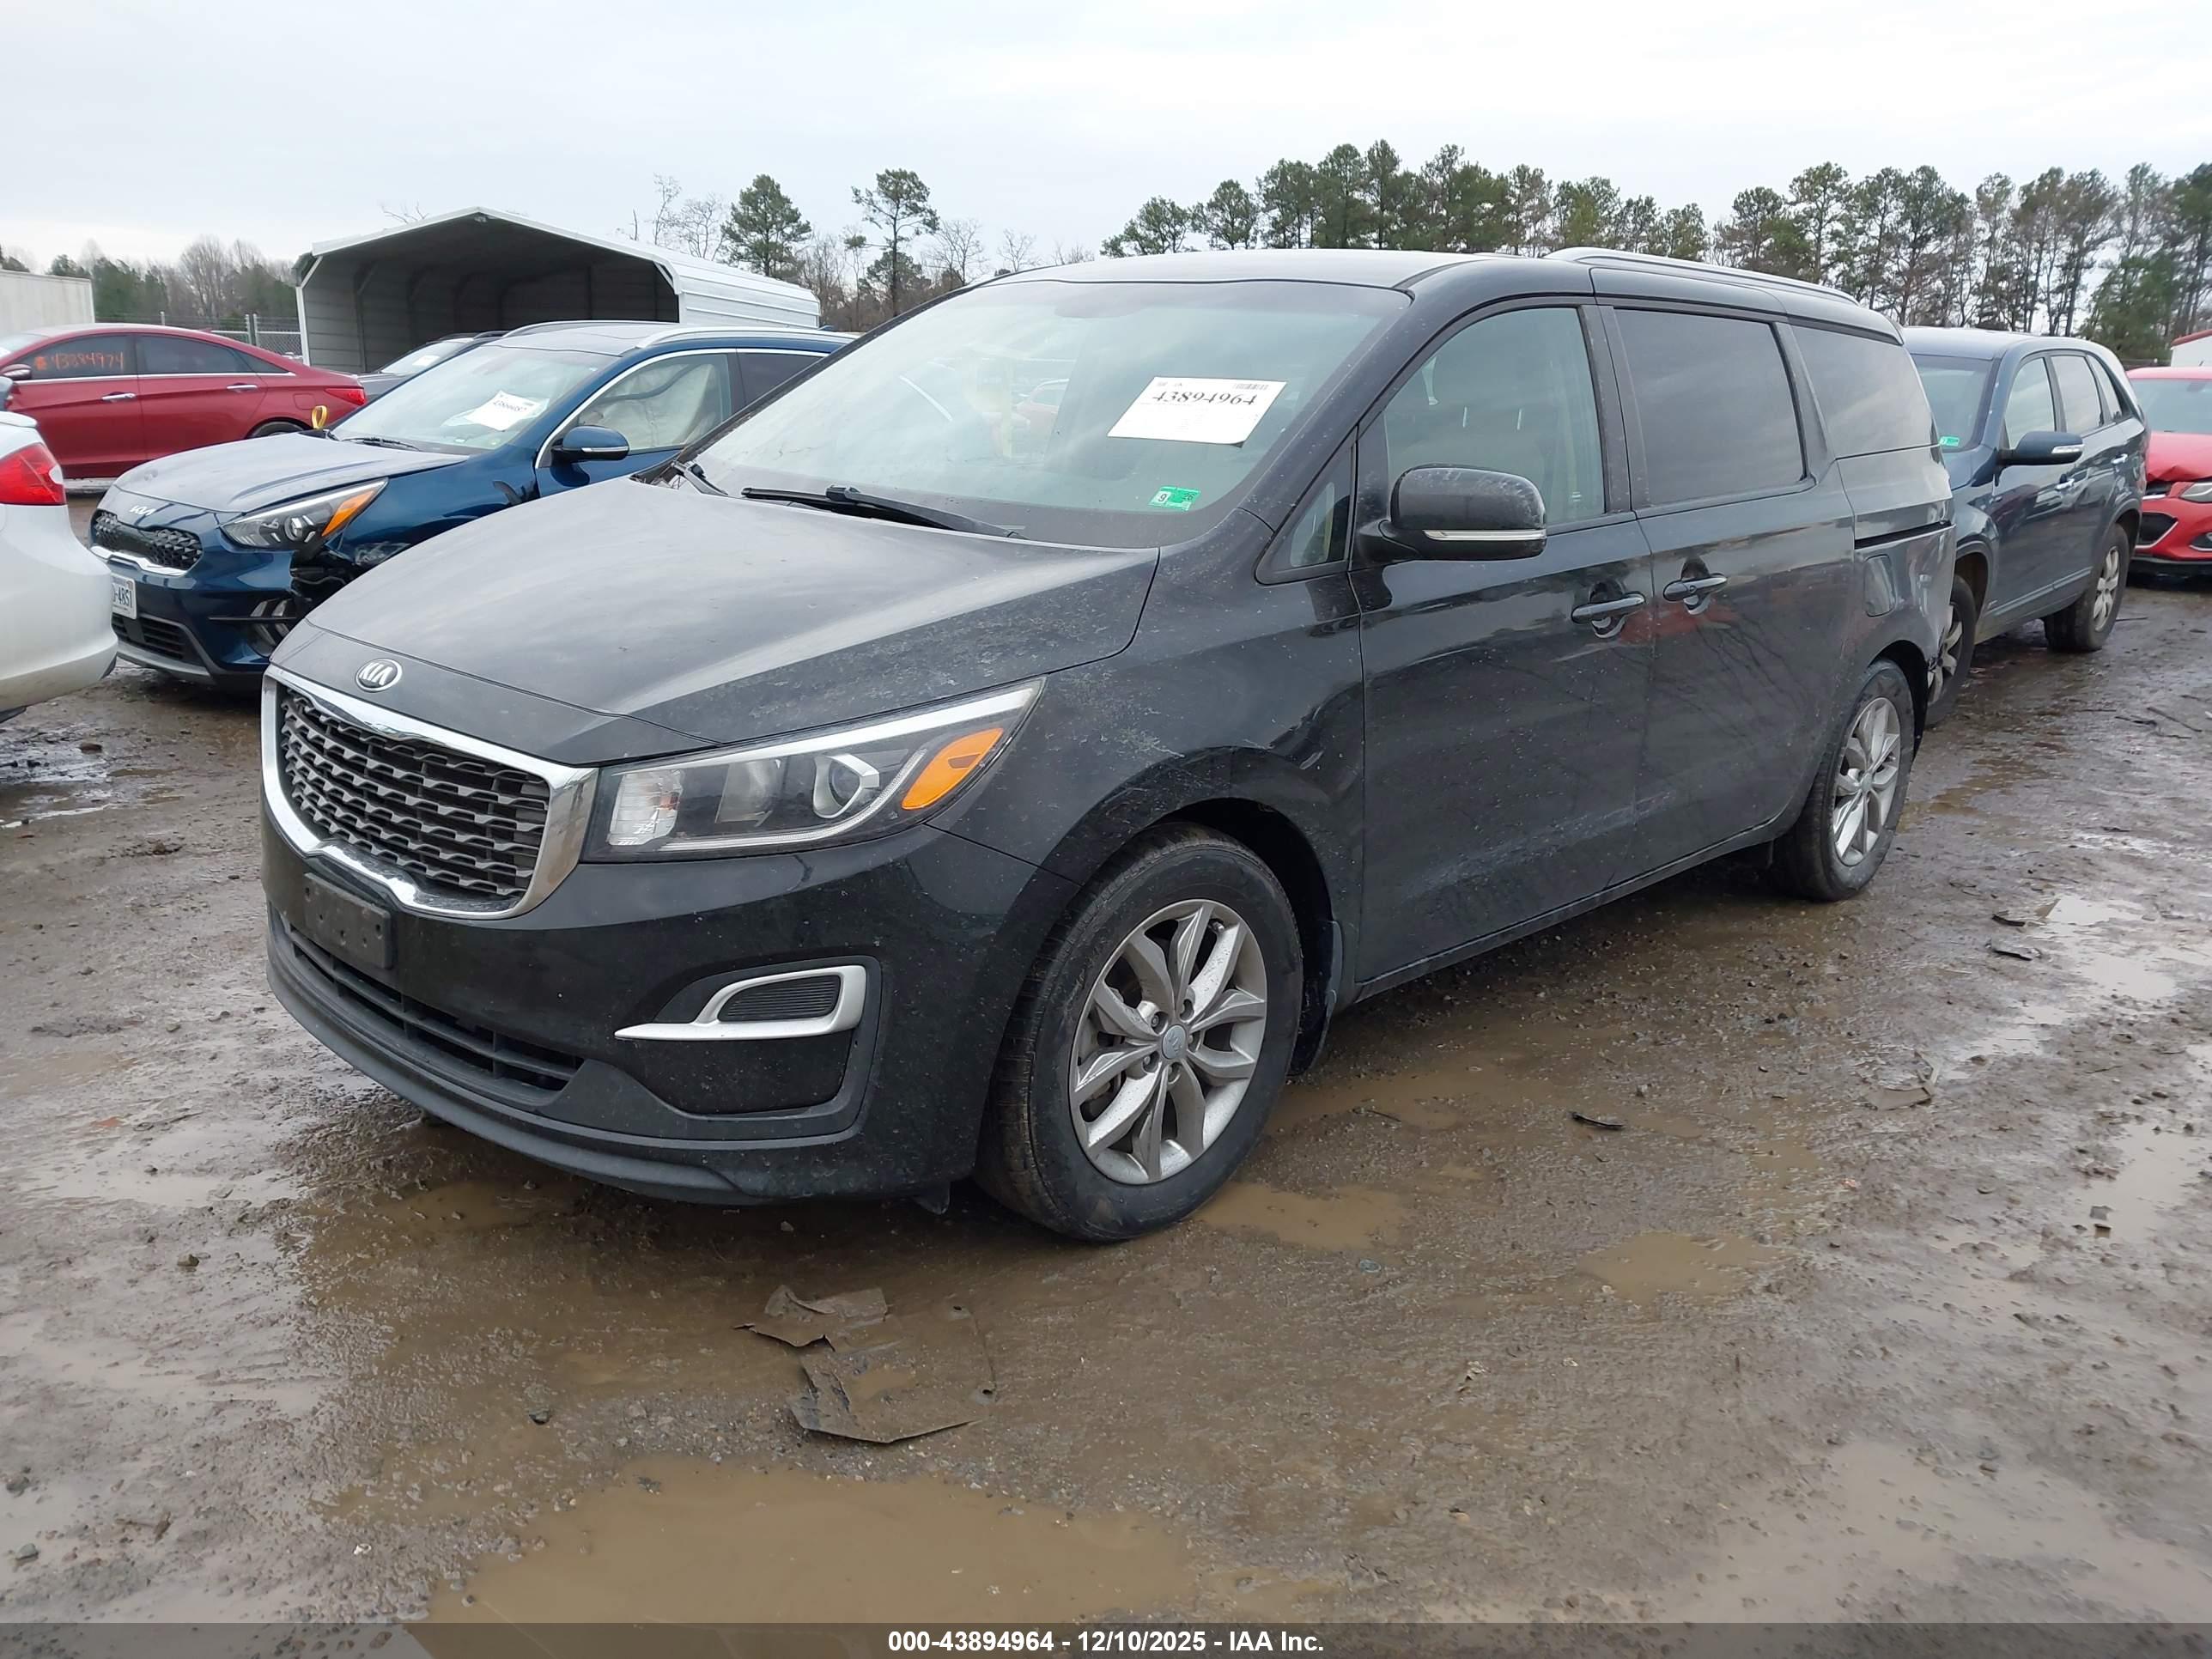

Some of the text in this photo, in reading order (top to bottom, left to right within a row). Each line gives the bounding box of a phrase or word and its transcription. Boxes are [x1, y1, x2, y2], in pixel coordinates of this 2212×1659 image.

[1152, 391, 1258, 405] 43894964
[1158, 493, 1167, 502] 9
[358, 661, 393, 686] KIA
